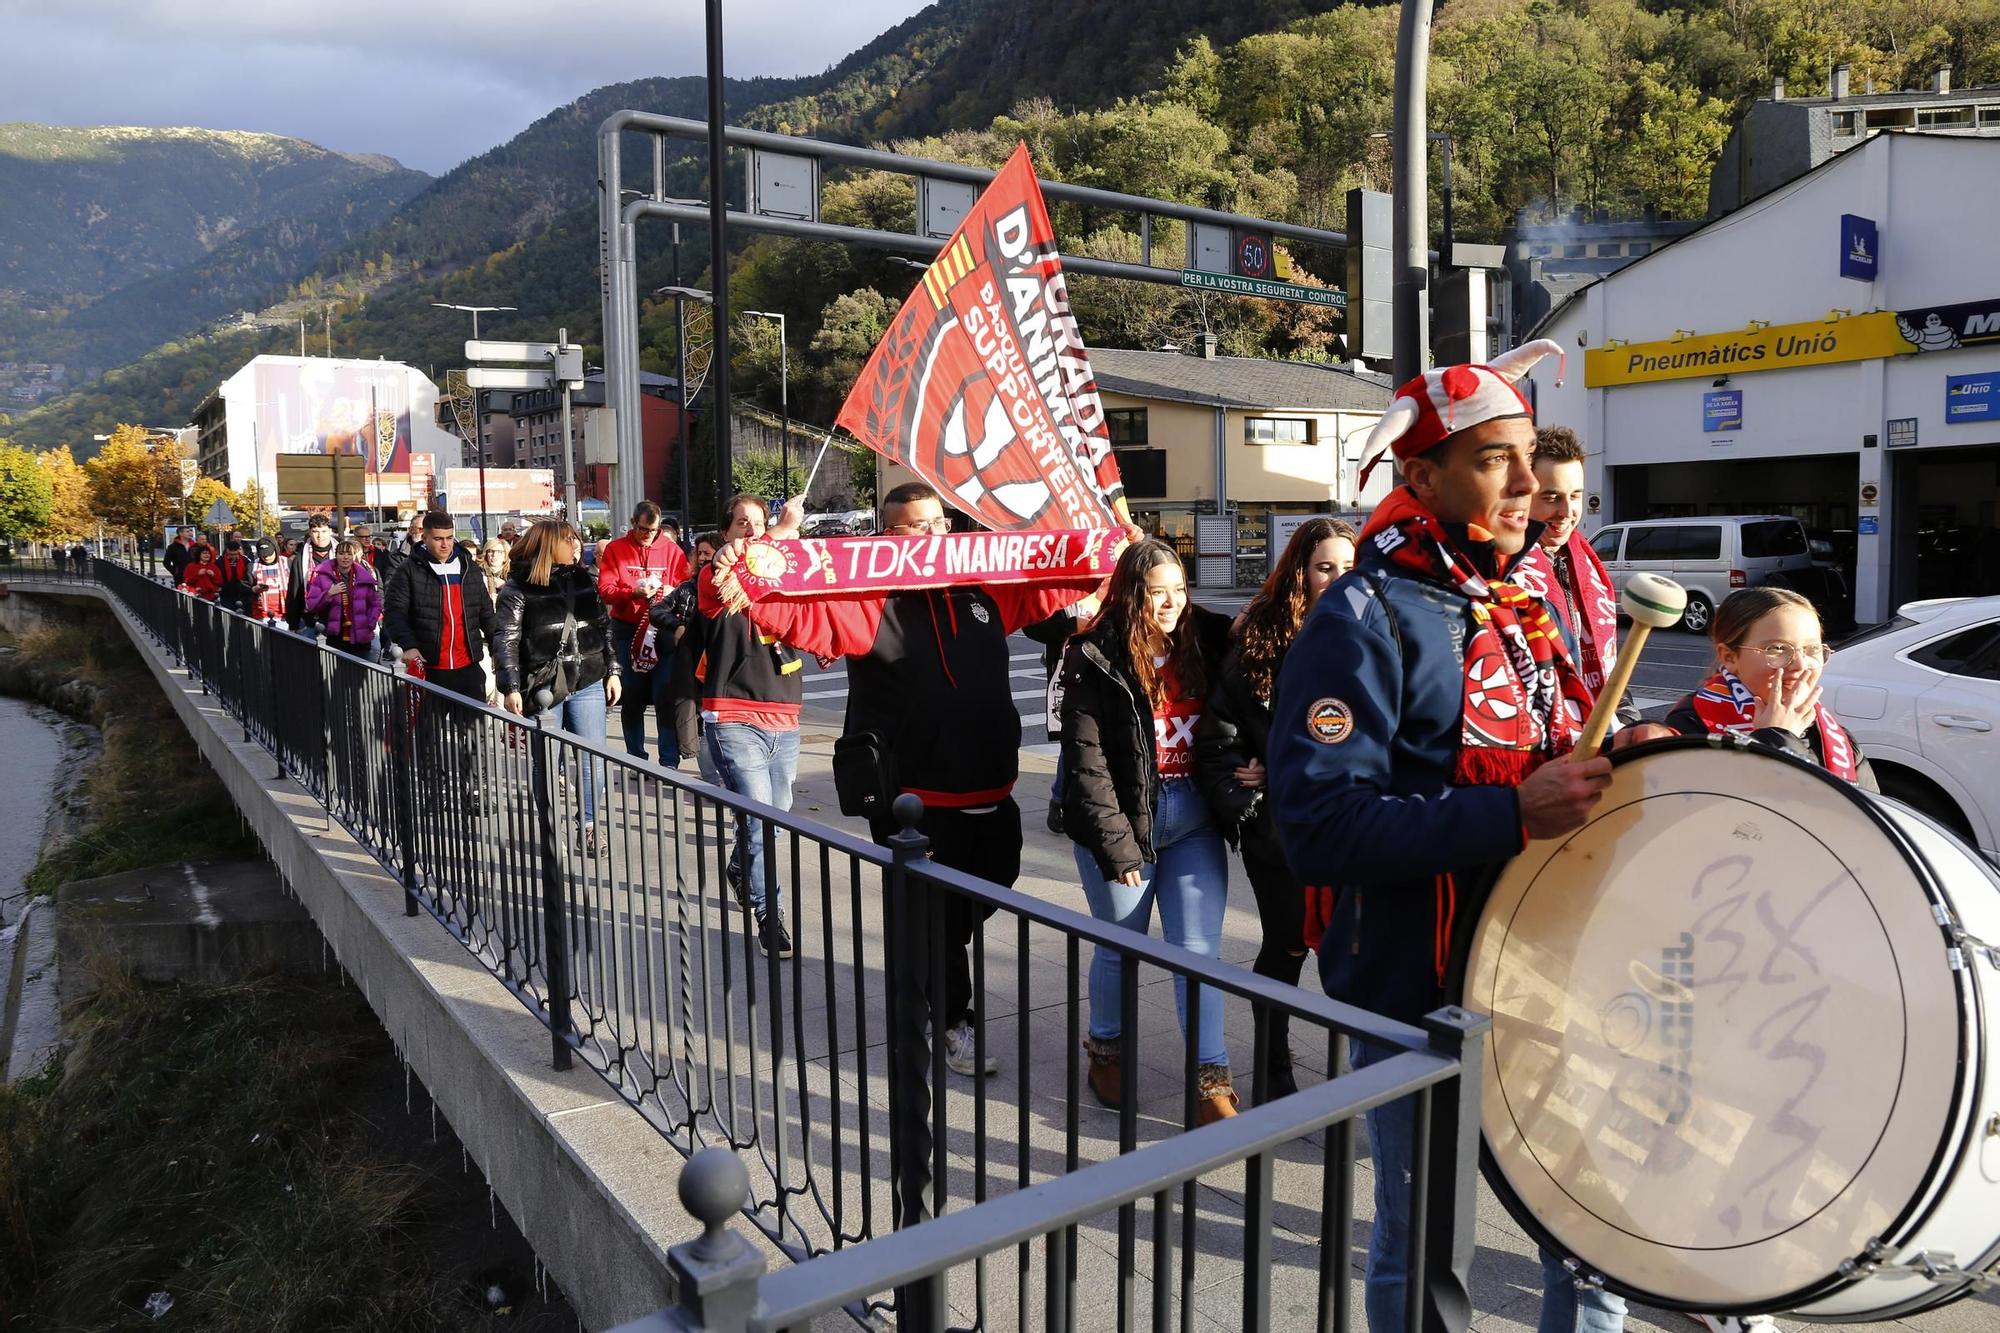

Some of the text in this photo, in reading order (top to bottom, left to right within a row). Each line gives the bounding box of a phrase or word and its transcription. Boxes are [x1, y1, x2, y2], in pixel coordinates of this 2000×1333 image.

[1244, 244, 1263, 269] 50
[1184, 272, 1346, 305] PER LA VOSTRA SEGURETAT CONTROL
[1628, 331, 1837, 374] Pneumàtics Unió
[964, 306, 1093, 529] SUPPORTERS
[945, 534, 1070, 574] MANRESA
